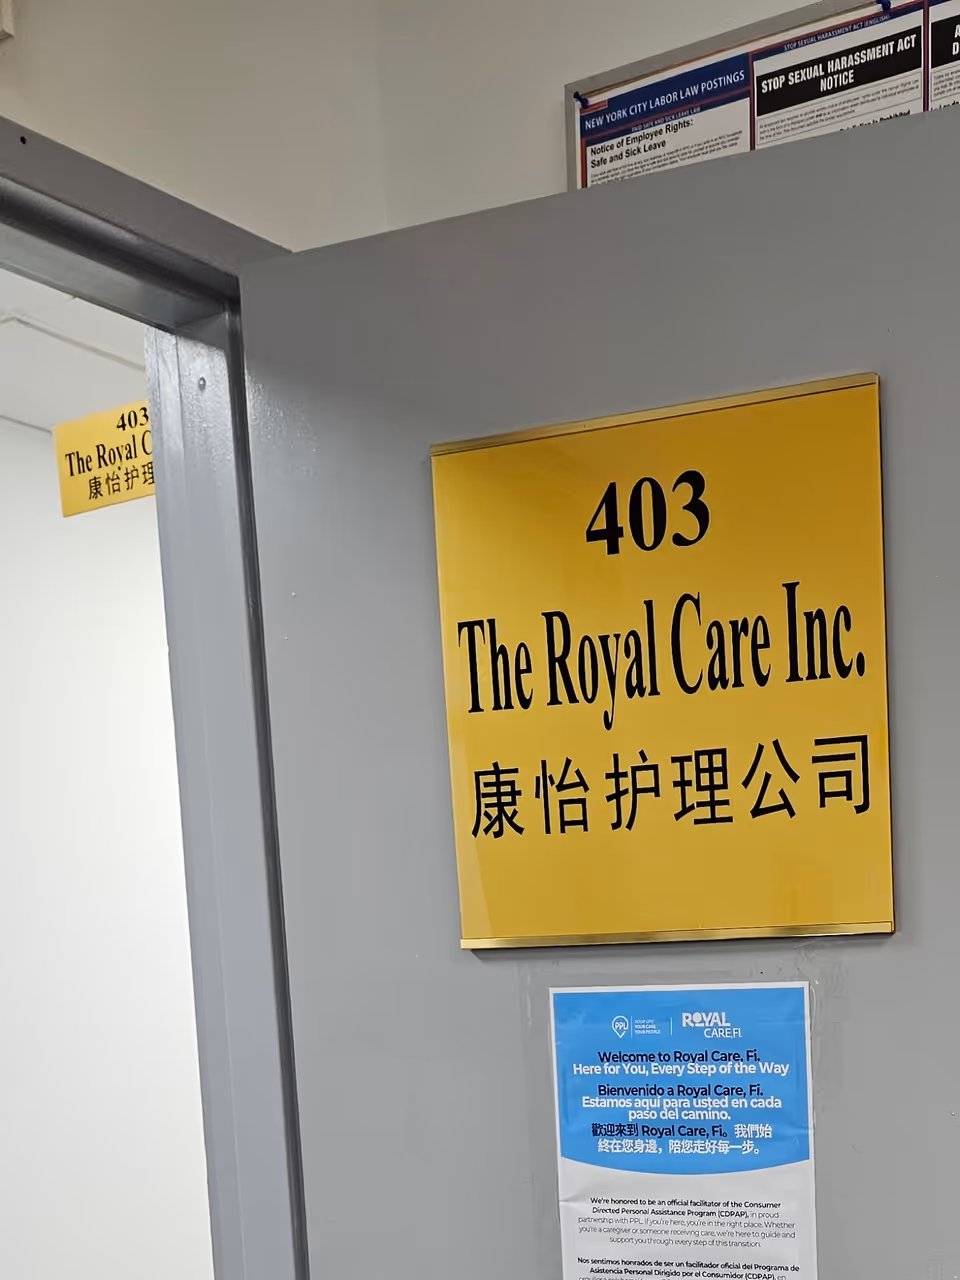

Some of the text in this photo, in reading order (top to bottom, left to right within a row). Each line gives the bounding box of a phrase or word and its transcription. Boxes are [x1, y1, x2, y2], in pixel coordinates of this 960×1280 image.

[762, 34, 916, 93] STOP SEXUAL HARASSMENT ACT
[821, 70, 854, 92] NOTICE
[585, 70, 744, 129] NEW YORK CITY LABOR LAW POSTINGS
[591, 119, 693, 156] Notice of Employee Rights:
[591, 140, 666, 168] Safe and Sick Leave
[116, 407, 149, 431] 403
[65, 451, 92, 477] The
[95, 435, 137, 471] Royal
[586, 470, 709, 555] 403
[458, 583, 865, 730] The Royal Care Inc.
[472, 735, 870, 839] 康怡护理公司
[573, 1062, 789, 1077] Here for You, Every Step of the Way
[597, 1049, 760, 1063] Welcome to Royal Care, Fi.
